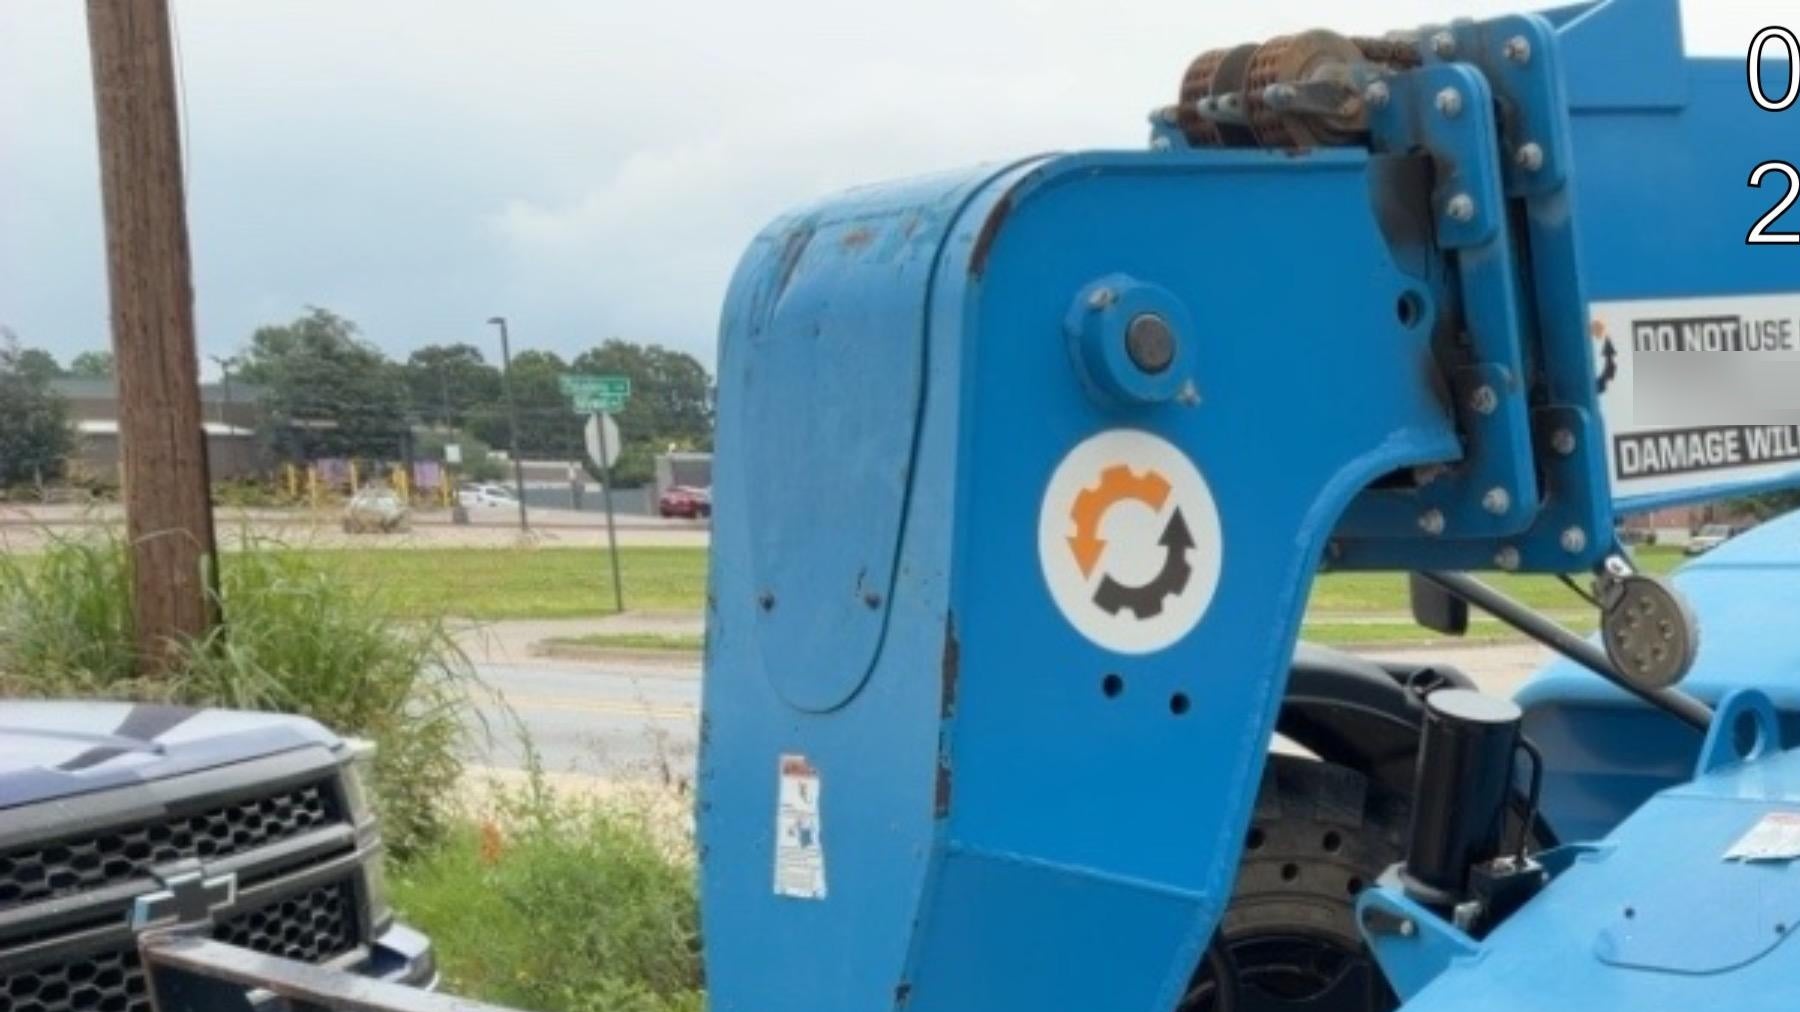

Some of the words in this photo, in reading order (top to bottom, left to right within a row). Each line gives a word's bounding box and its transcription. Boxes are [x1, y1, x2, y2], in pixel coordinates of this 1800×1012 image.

[1682, 322, 1738, 351] NOT
[1745, 319, 1793, 350] USE
[1618, 429, 1742, 477] DAMAGE
